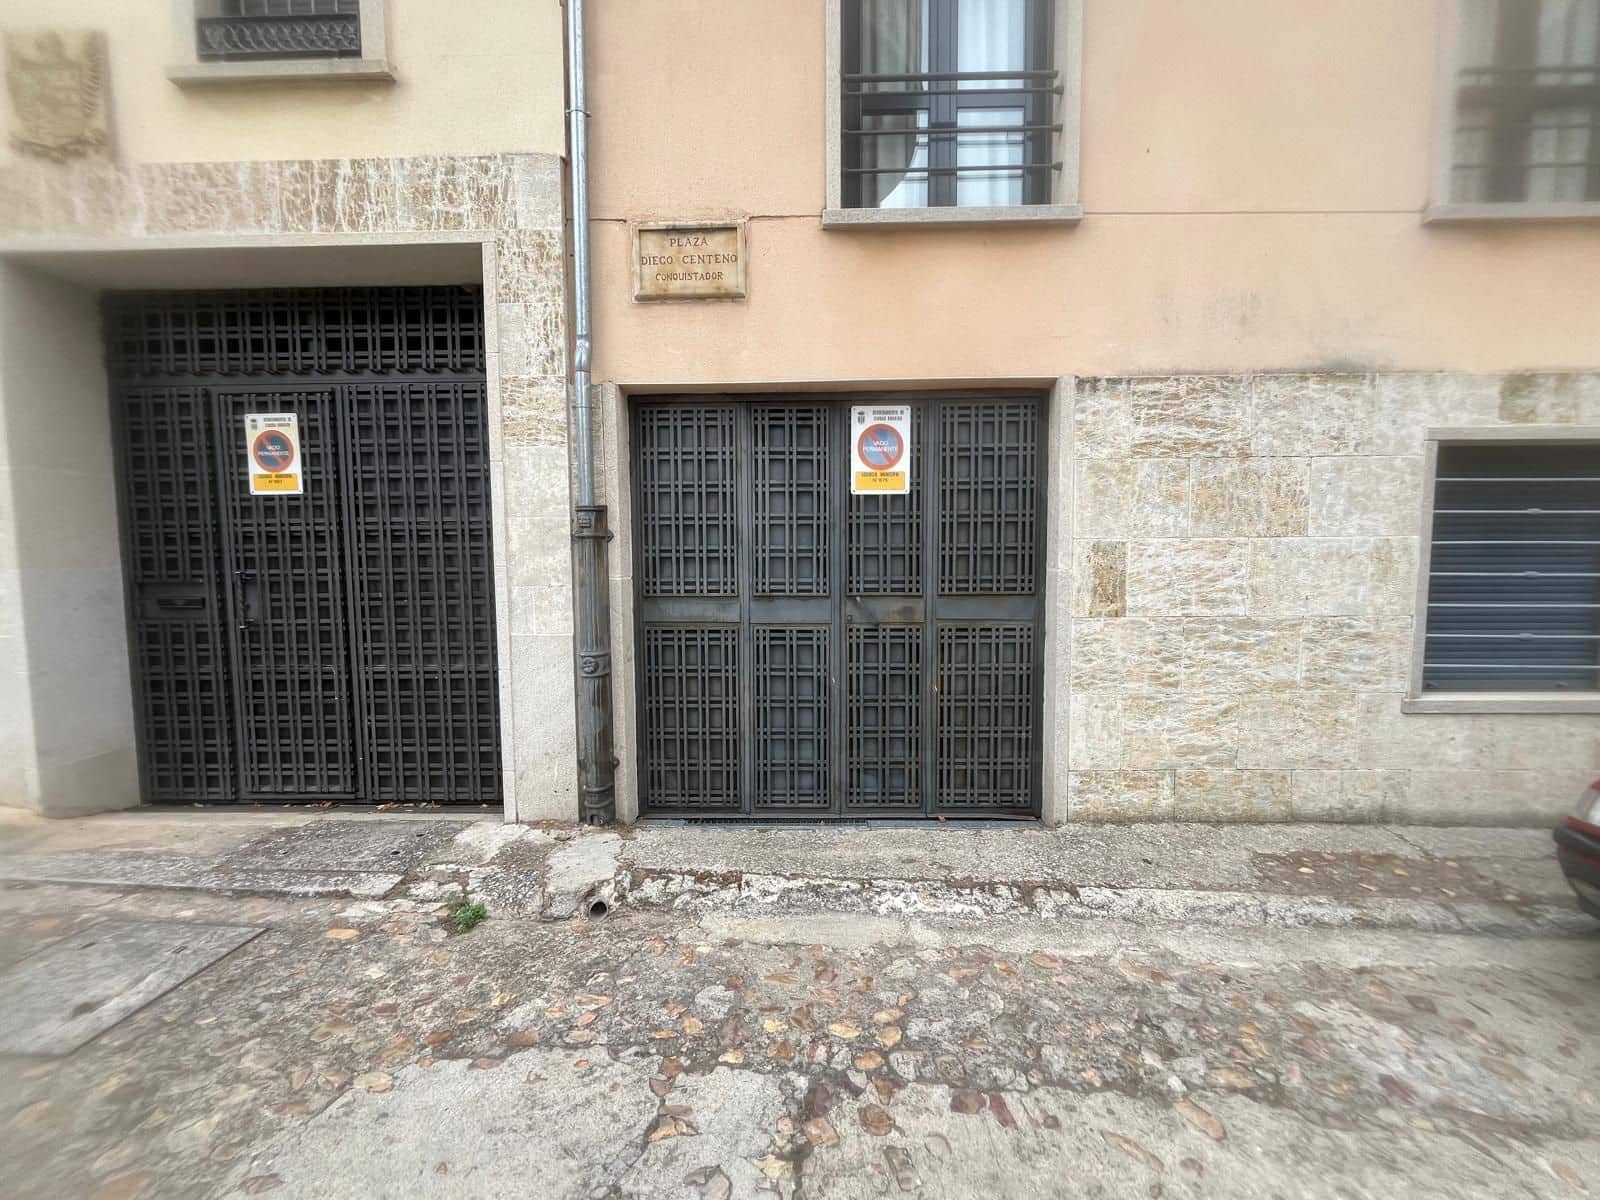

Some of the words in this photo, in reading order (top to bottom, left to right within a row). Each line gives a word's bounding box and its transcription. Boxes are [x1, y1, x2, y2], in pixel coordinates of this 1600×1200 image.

[669, 237, 709, 247] PLAZA
[641, 256, 673, 265] DIEGO
[682, 254, 738, 265] CENTENO
[655, 272, 724, 281] CONQUISTADOR
